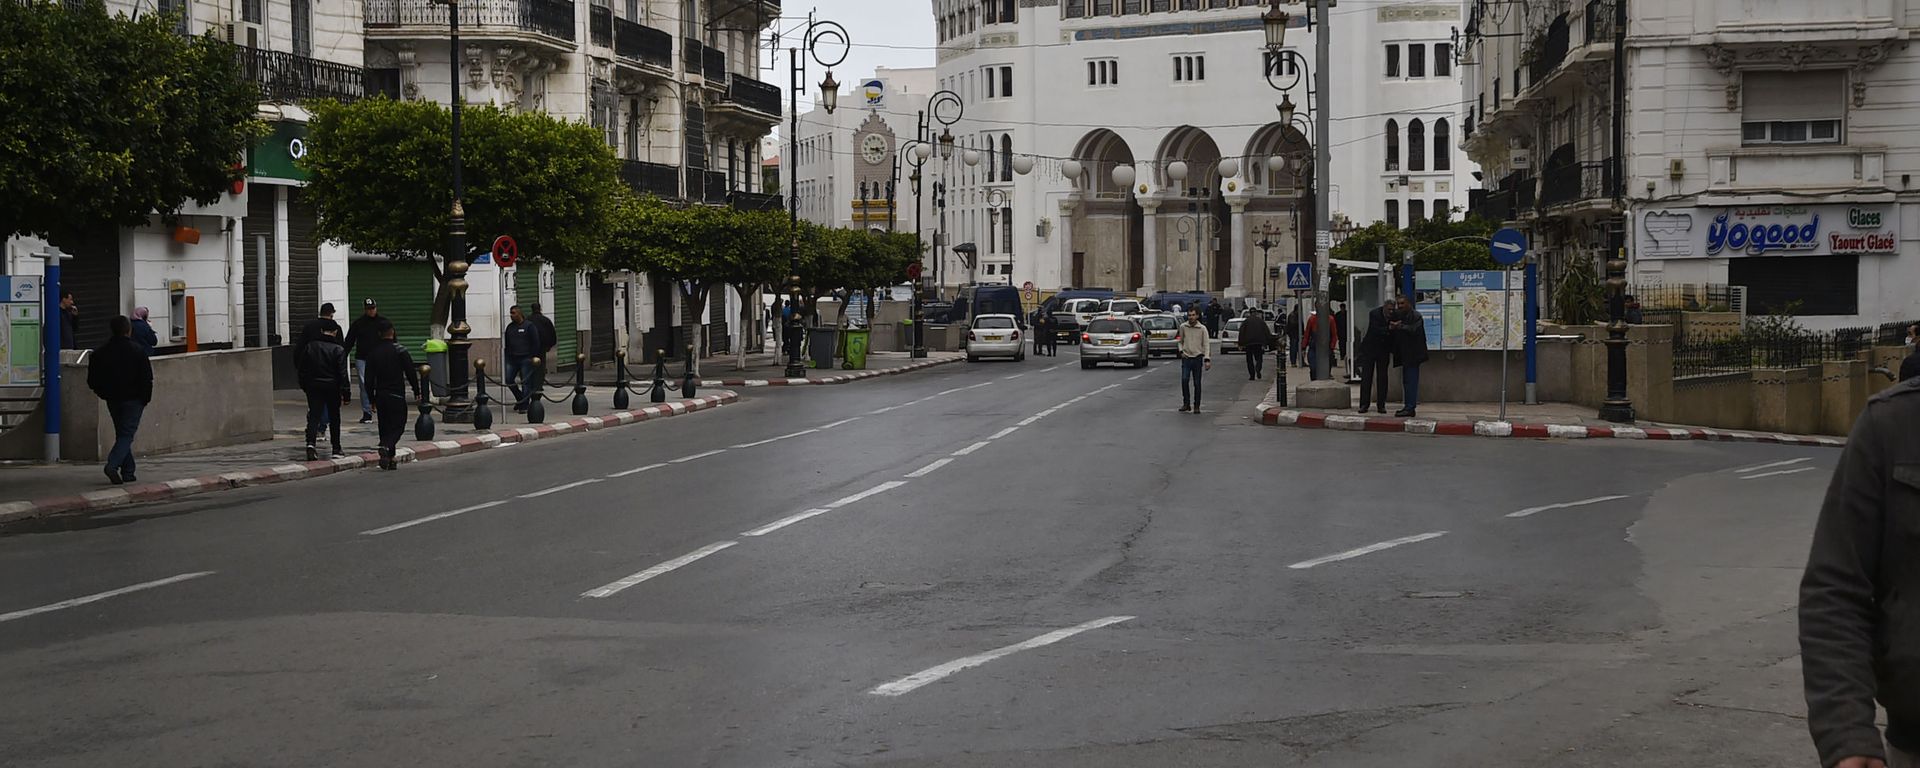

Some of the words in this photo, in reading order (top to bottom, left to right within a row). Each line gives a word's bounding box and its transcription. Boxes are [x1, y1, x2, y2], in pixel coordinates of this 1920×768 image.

[1849, 208, 1881, 226] Glaces
[1831, 234, 1865, 250] Yaourt
[1867, 232, 1894, 250] Glacé
